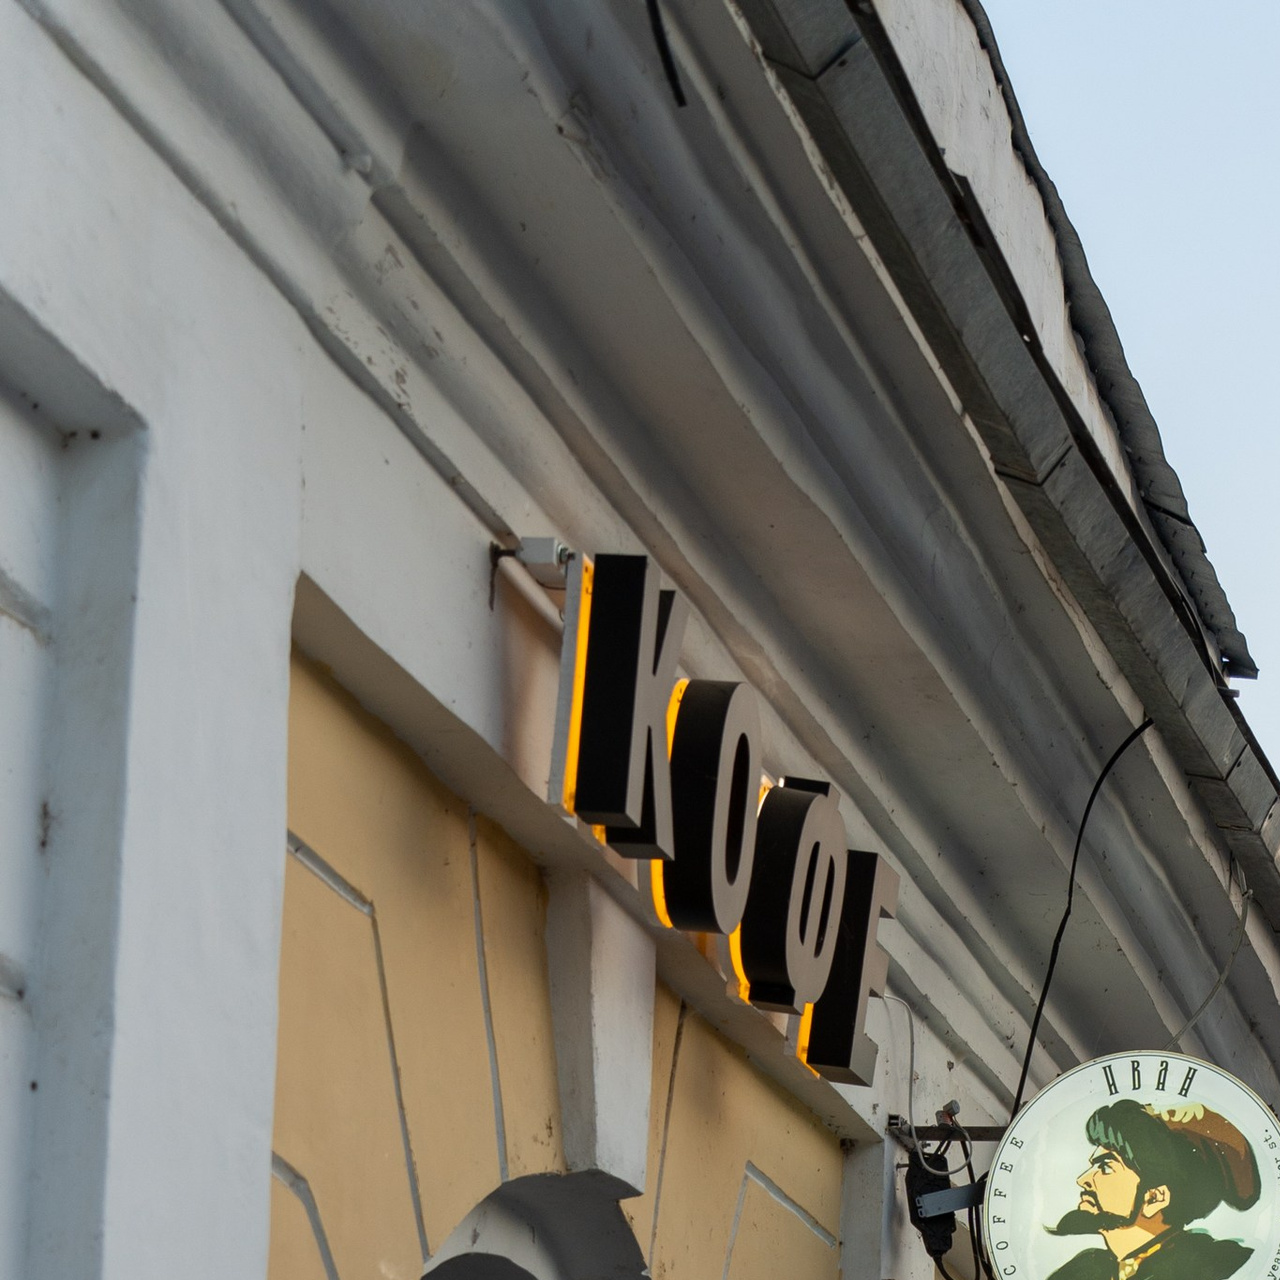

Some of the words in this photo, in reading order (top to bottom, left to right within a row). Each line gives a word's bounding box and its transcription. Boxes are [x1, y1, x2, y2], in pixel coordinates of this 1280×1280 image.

[574, 553, 901, 1088] КОФЕ
[1101, 1060, 1198, 1098] ИВАН
[1263, 1128, 1277, 1150] st.
[992, 1136, 1024, 1276] COFFEE
